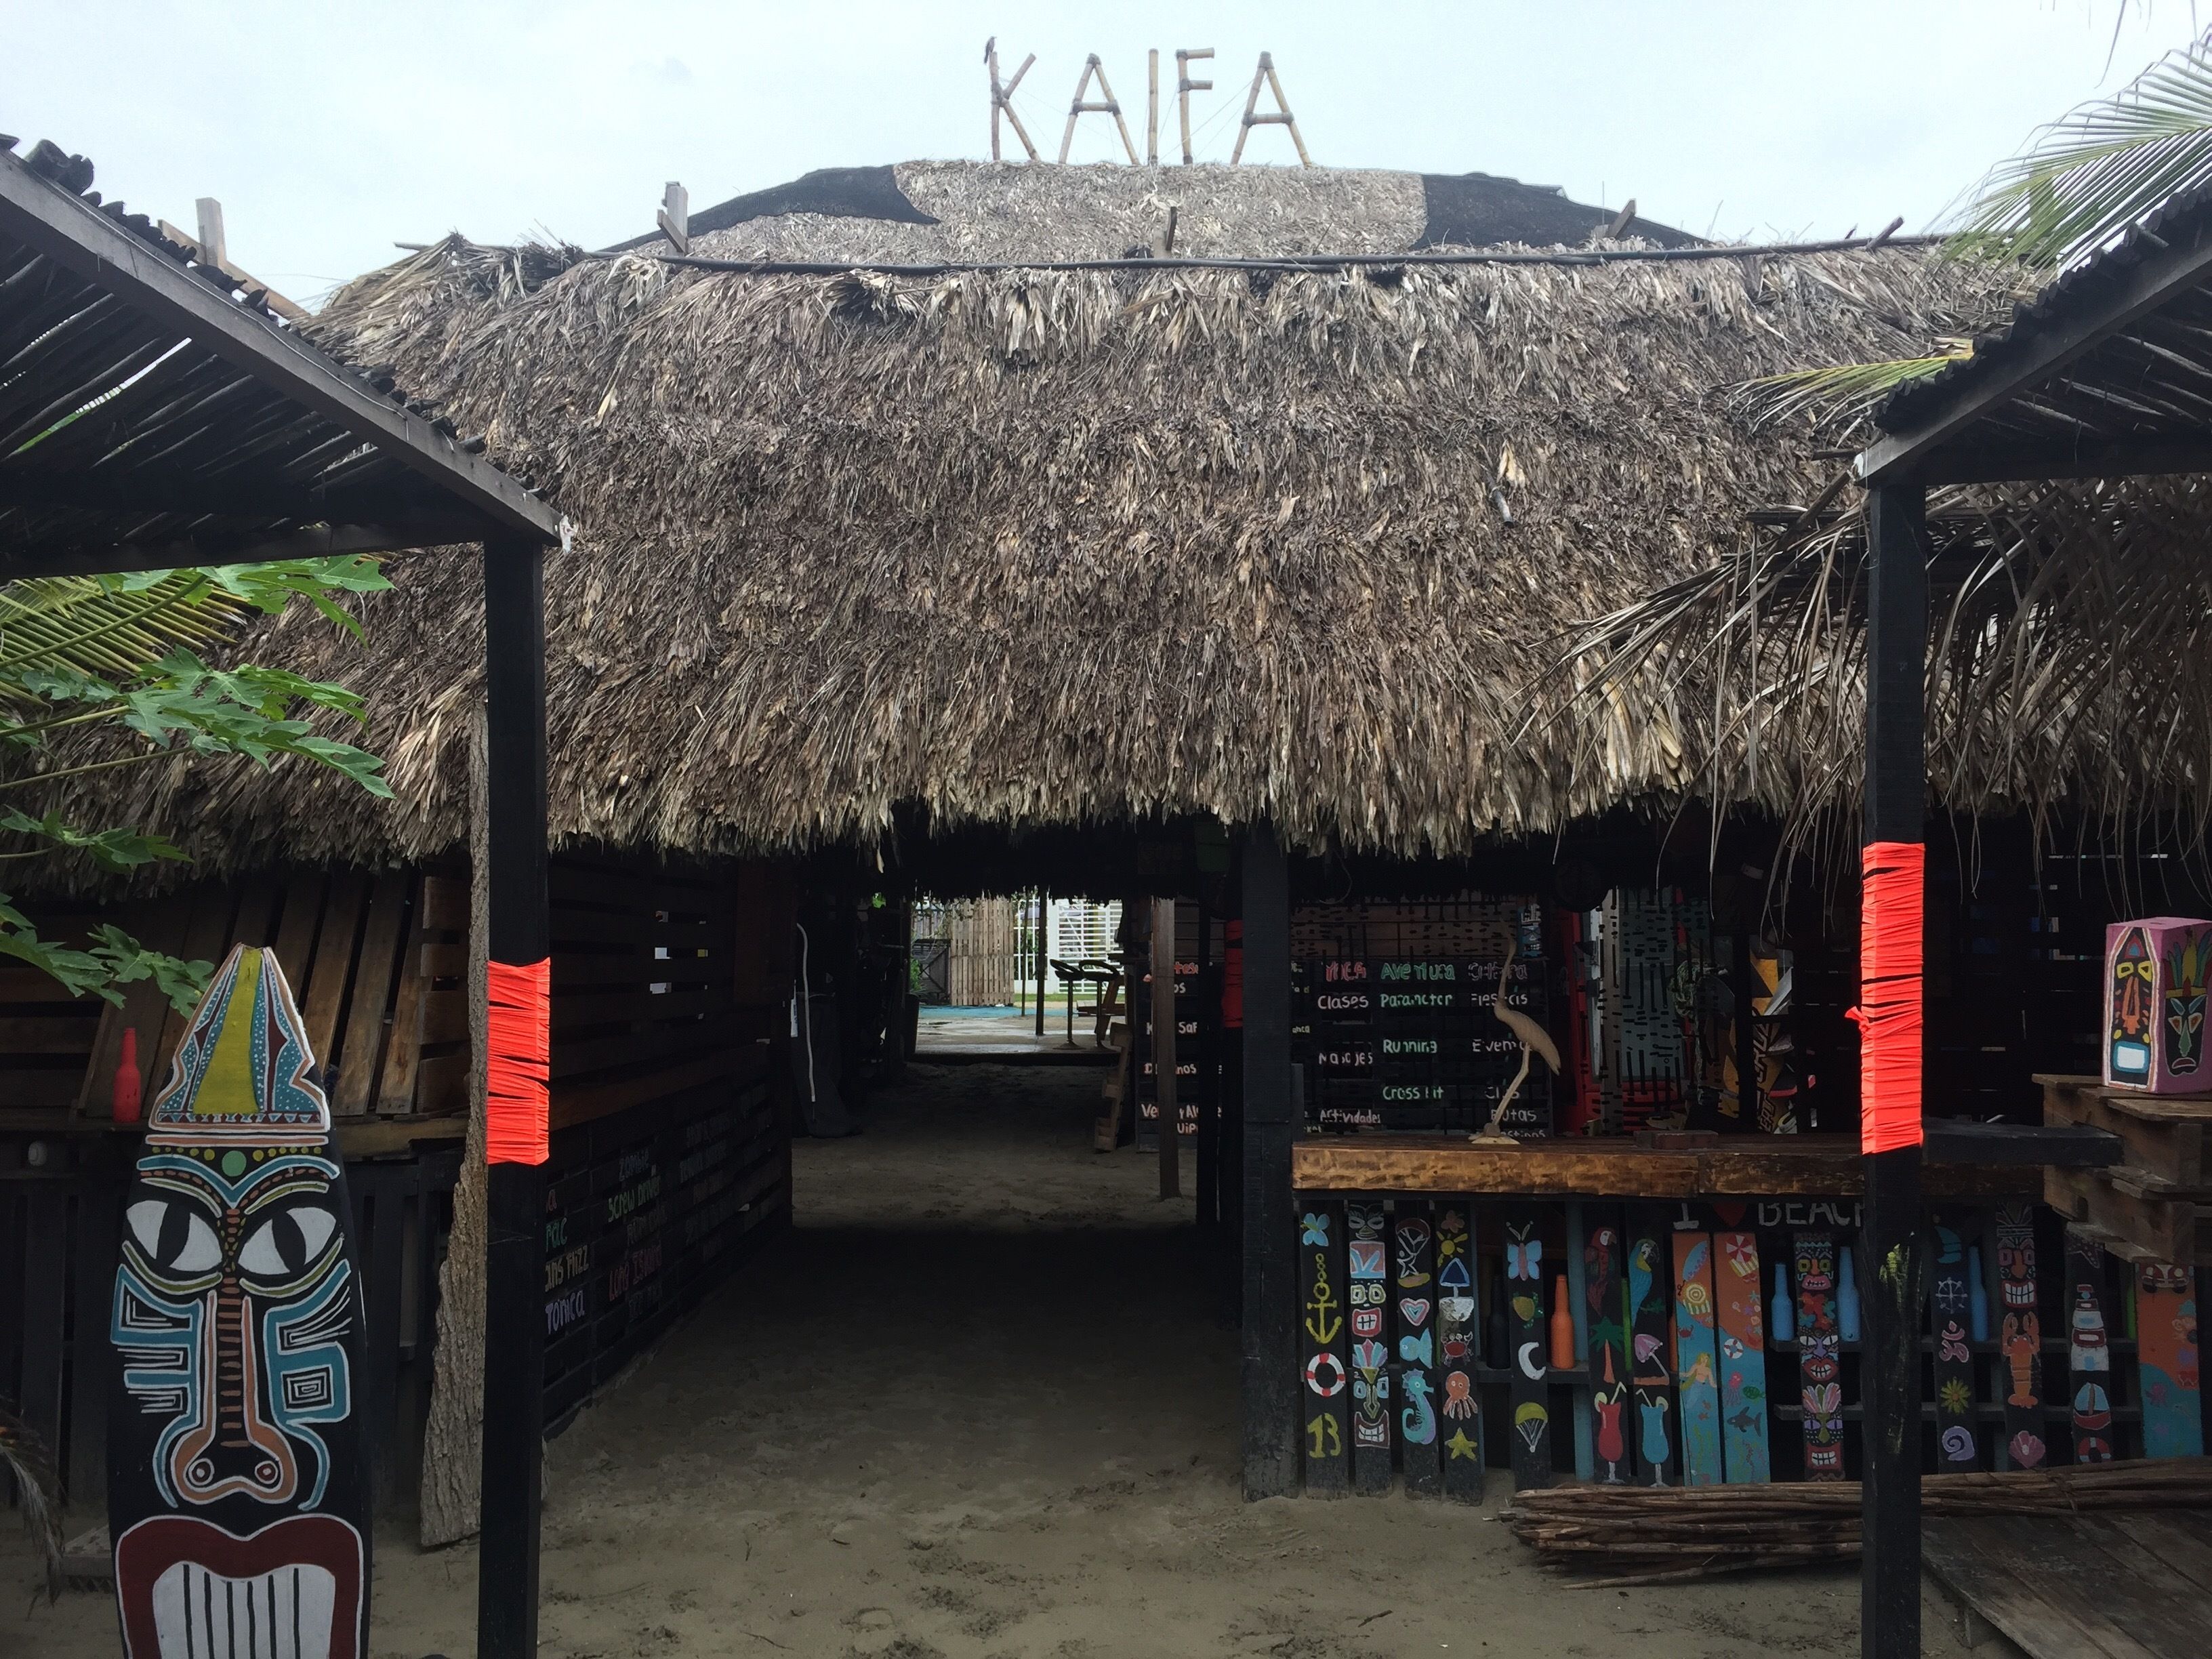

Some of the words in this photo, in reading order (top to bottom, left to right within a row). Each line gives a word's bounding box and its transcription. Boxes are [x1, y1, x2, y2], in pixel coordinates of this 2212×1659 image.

[989, 47, 1313, 168] KAIFA
[1317, 994, 1369, 1010] Clases
[1471, 993, 1528, 1006] Fiesas
[1382, 1039, 1437, 1053] Running
[1382, 1086, 1420, 1101] Cross
[1319, 1108, 1382, 1124] Actividades
